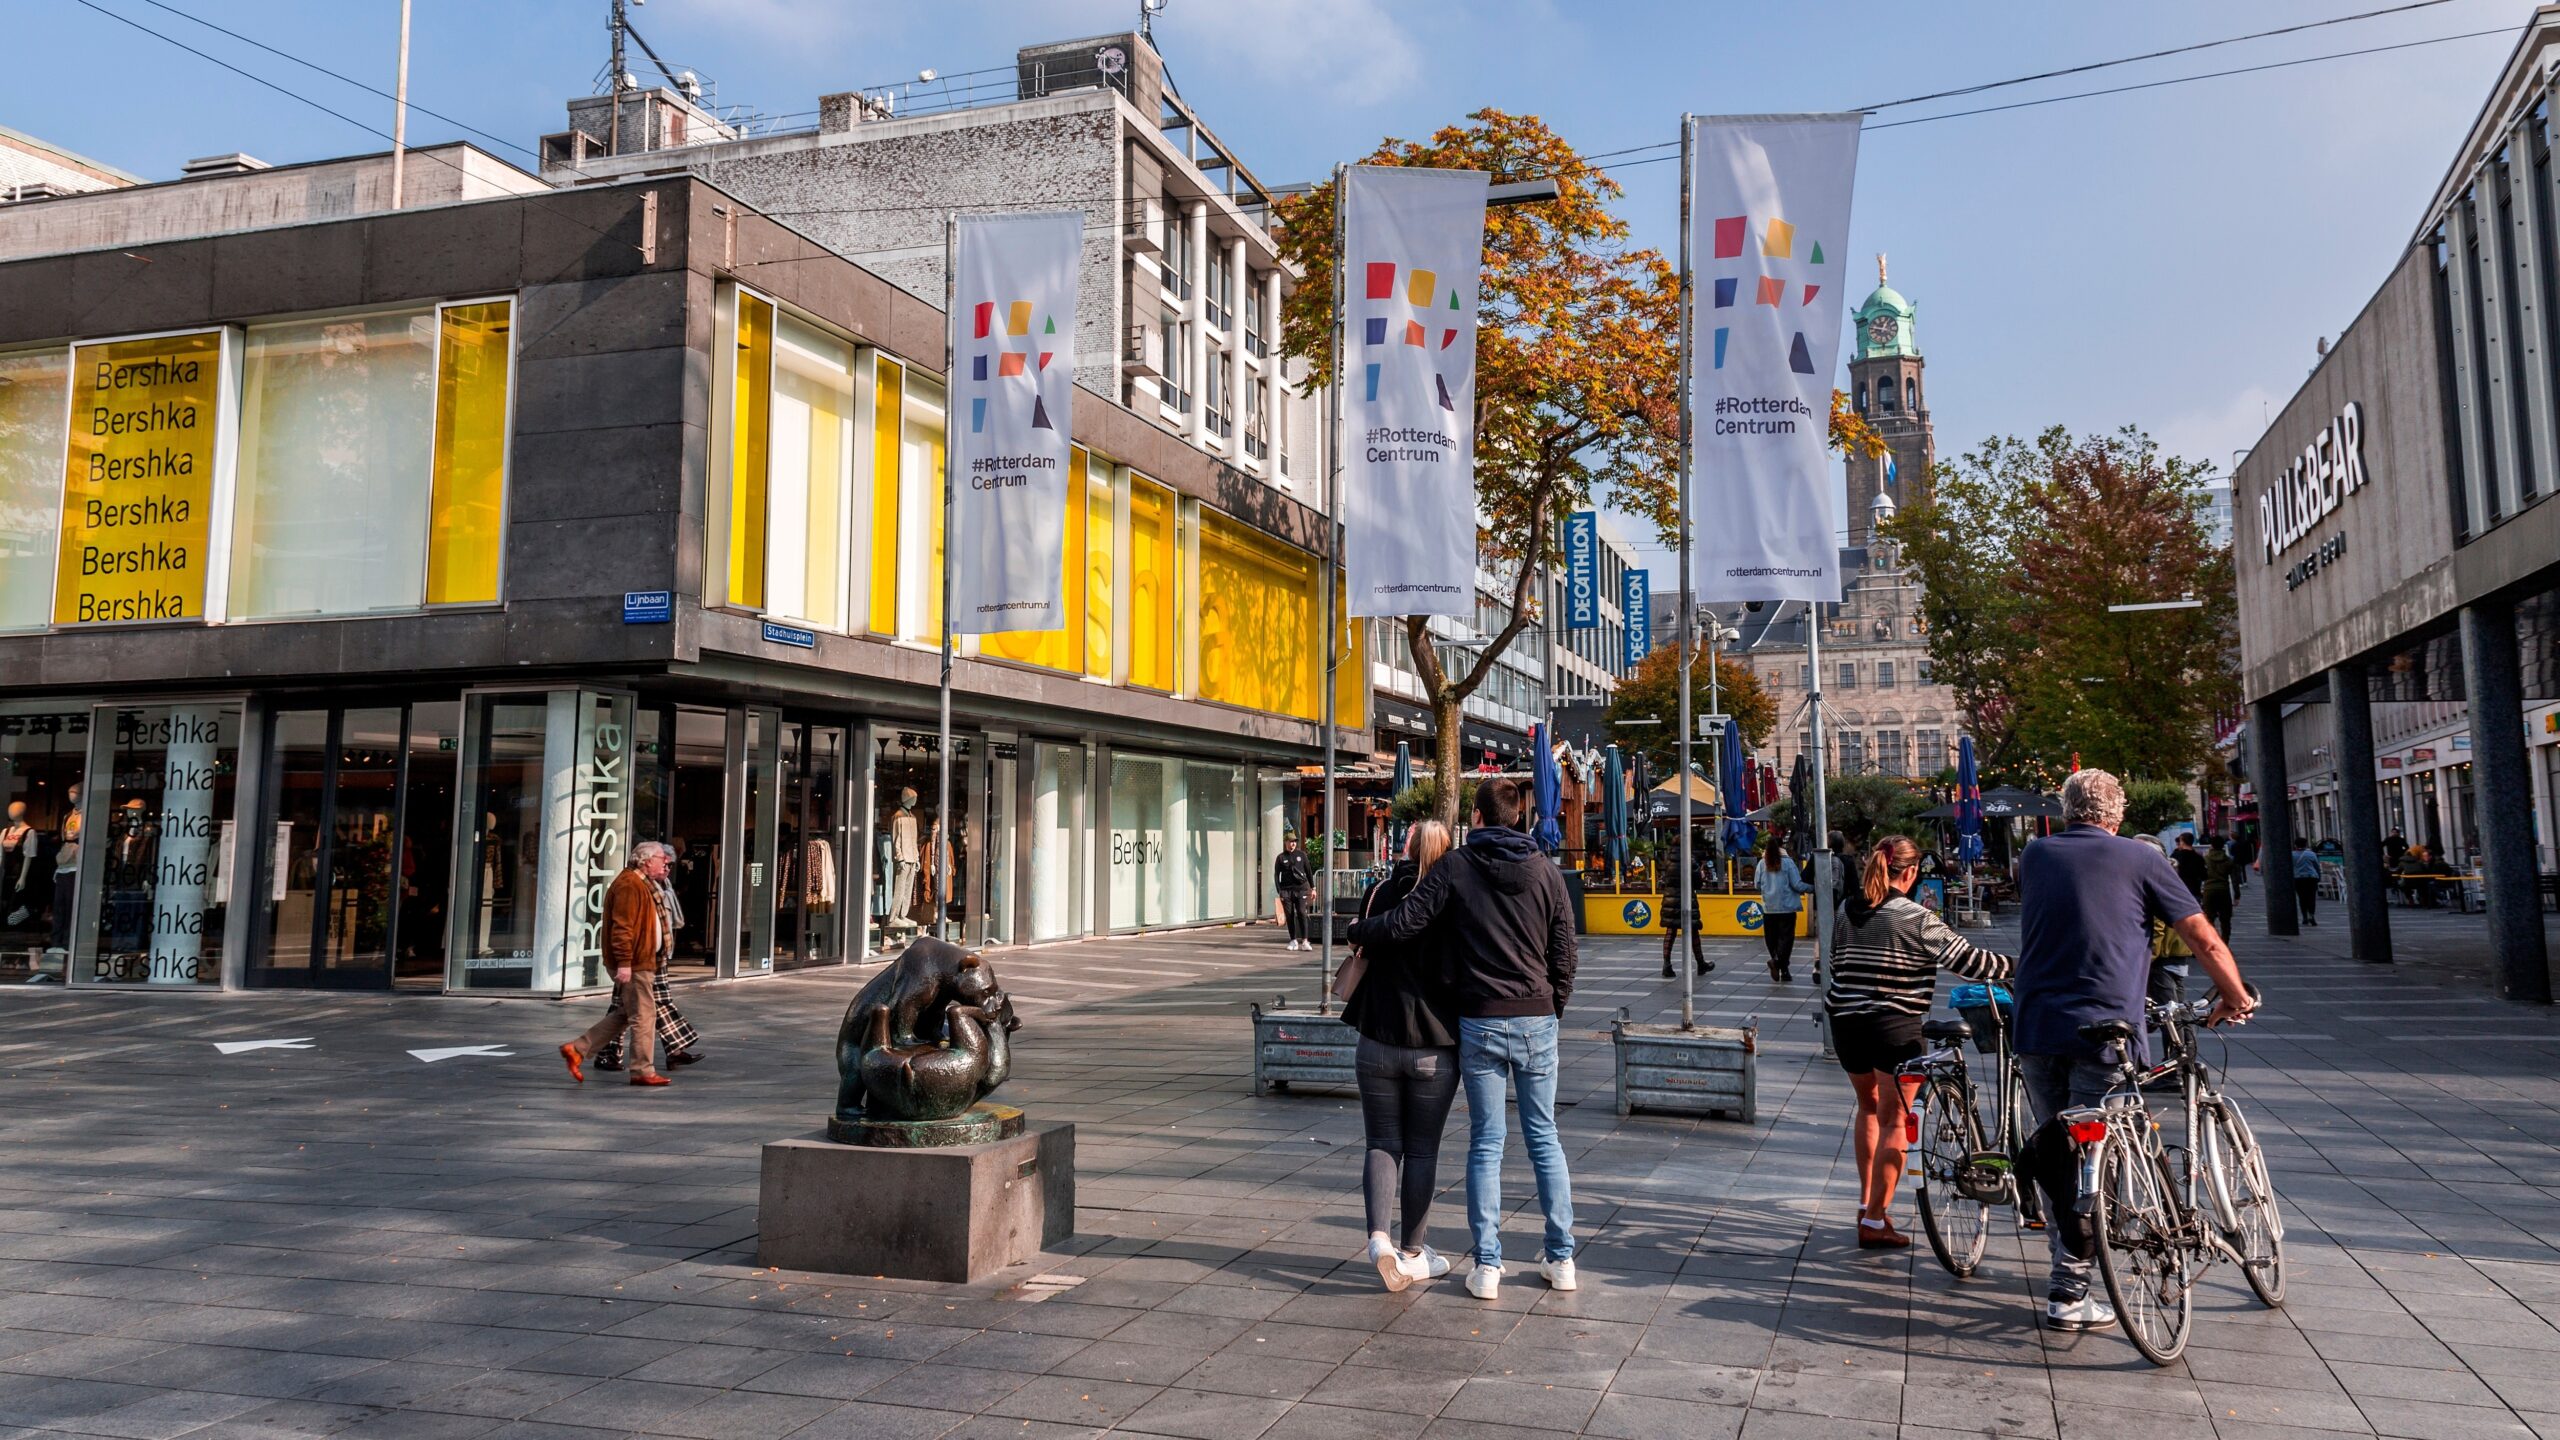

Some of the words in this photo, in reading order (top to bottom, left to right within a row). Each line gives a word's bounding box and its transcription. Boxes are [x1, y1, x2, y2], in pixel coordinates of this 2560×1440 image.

[96, 355, 199, 390] Bershka
[93, 401, 196, 436] Bershka
[1715, 419, 1796, 435] Centrum
[1366, 428, 1457, 451] #Rotterdam
[1366, 447, 1439, 463] Centrum
[89, 447, 193, 482] Bershka
[972, 474, 1027, 490] Centrum
[2259, 401, 2368, 566] PULL&BEAR
[86, 494, 190, 529] Bershka
[82, 541, 187, 576] Bershka
[1572, 518, 1591, 622] DECATHLON
[1726, 567, 1822, 577] rotterdamcentrum.nl
[78, 589, 183, 622] Bershka
[628, 594, 665, 607] Lijnbaan
[767, 626, 812, 643] Stadhuisplein
[1628, 575, 1645, 662] DECATHLON
[115, 714, 220, 745] Bershka
[108, 808, 213, 840] Beshka
[1113, 833, 1163, 865] Bershk
[95, 948, 200, 979] Bershka
